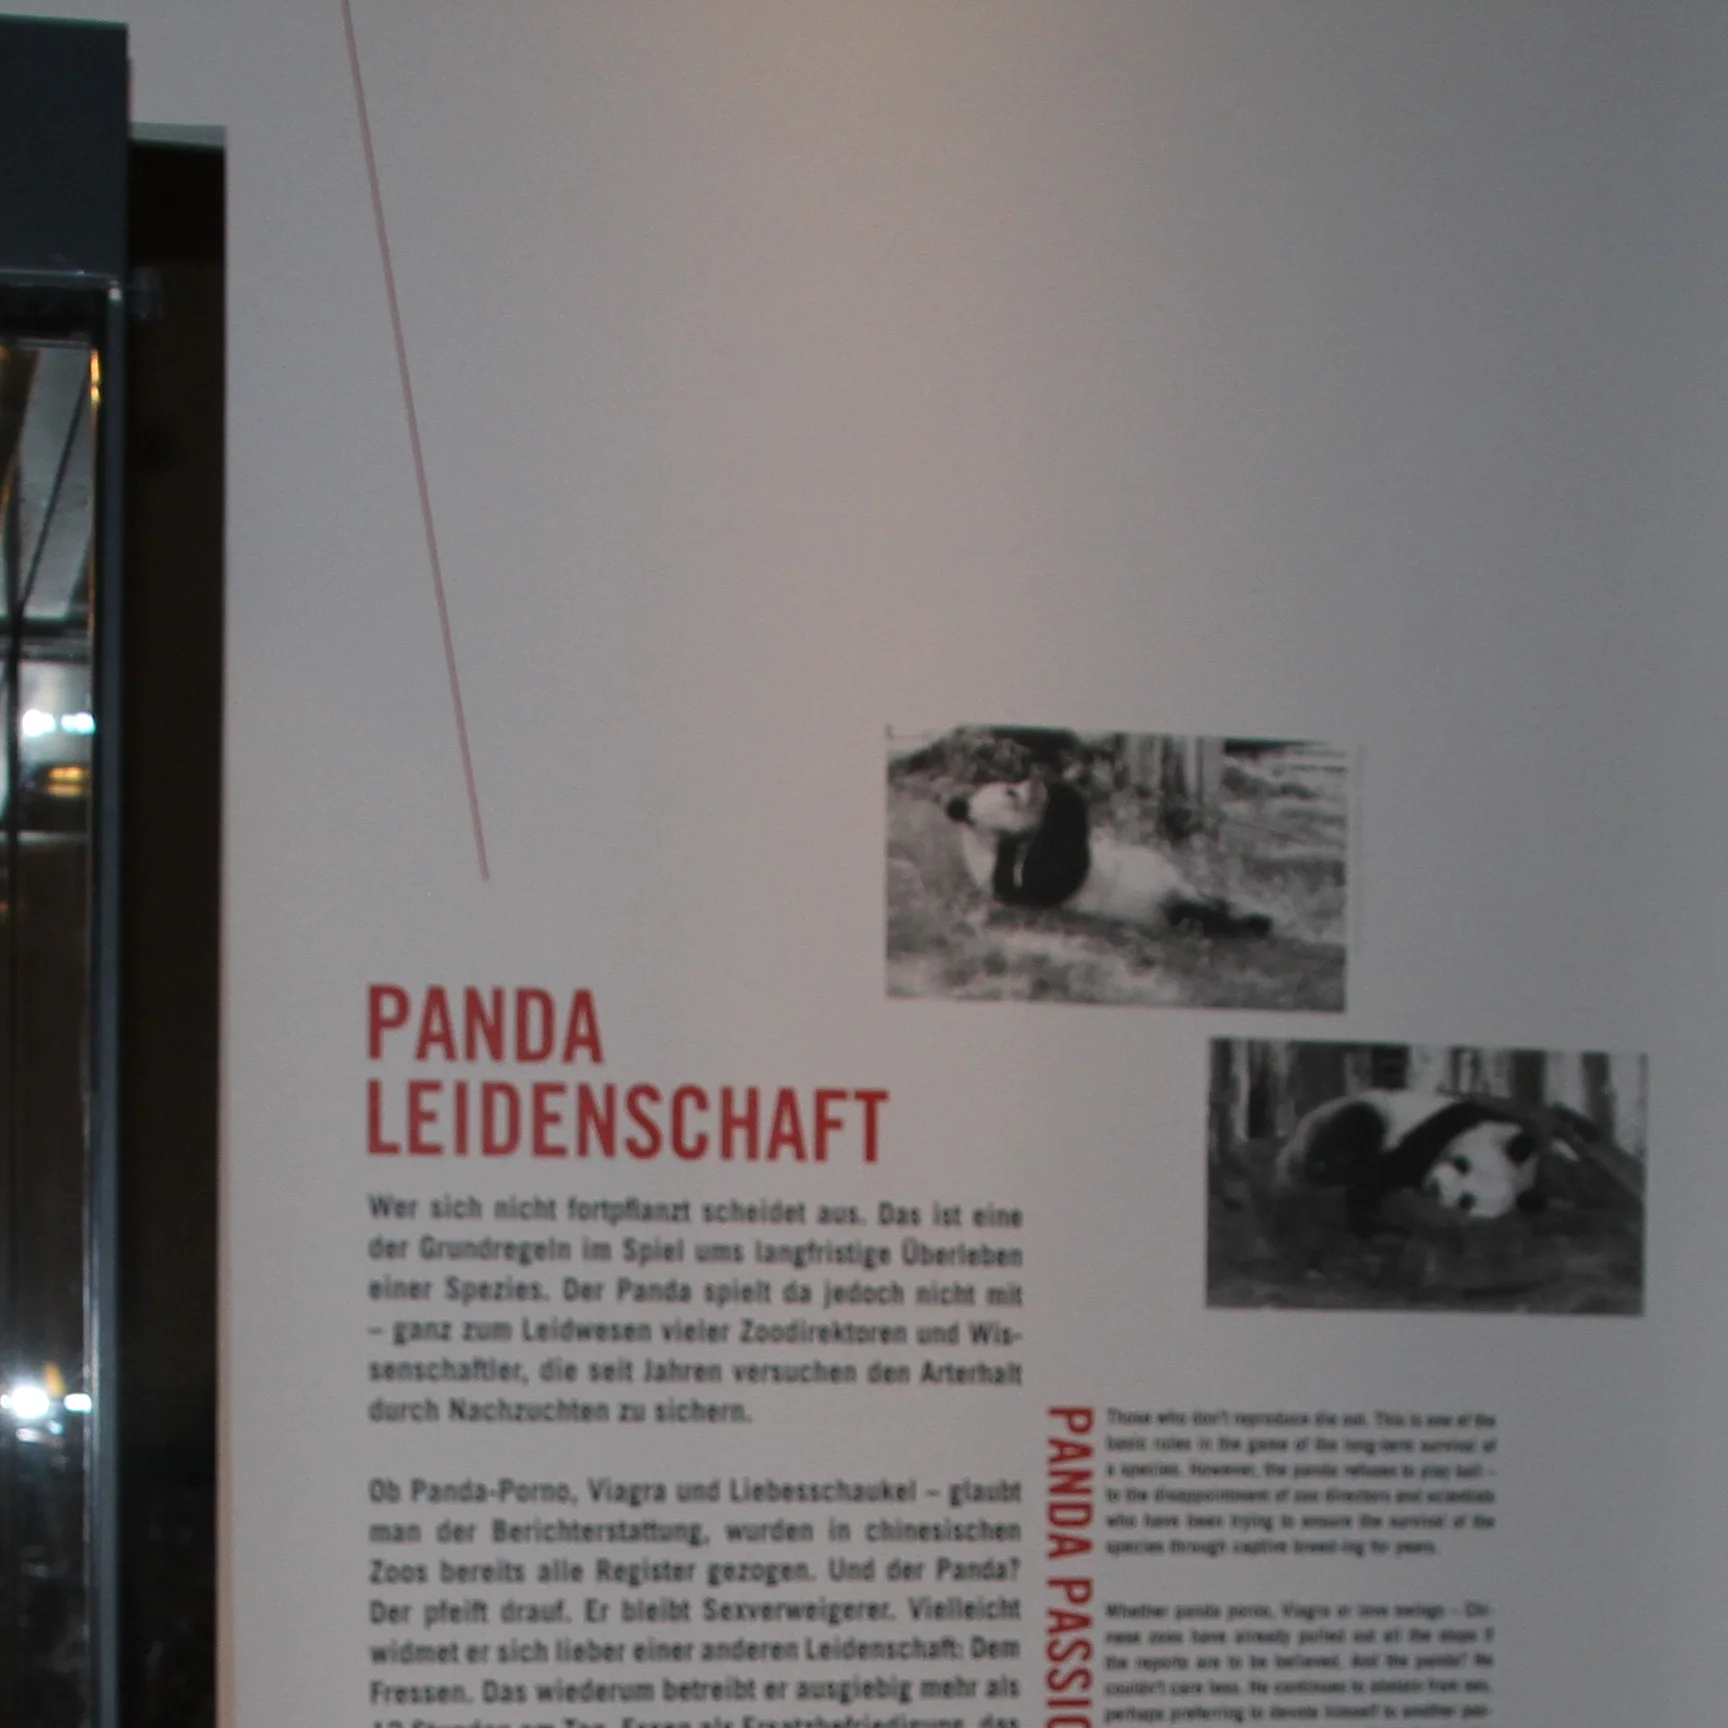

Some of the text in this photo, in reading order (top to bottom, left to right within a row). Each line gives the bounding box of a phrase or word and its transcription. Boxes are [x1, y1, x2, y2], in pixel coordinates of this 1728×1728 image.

[368, 984, 604, 1064] PANDA
[368, 1080, 889, 1162] LEIDENSCHAFT
[367, 1195, 1024, 1229] Wer sich nicht fortpflanzt scheidet aus. Das ist eine
[367, 1235, 1023, 1271] der Grundregeln im Spiel ums langfristige Überleben
[367, 1276, 1023, 1310] einer Spezies. Der Panda spielt da jedoch nicht mit
[392, 1318, 1022, 1347] ganz zum Leidwesen vieler Zoodirektoren und Wis-
[539, 1358, 578, 1383] die
[588, 1360, 634, 1383] seit
[643, 1359, 723, 1384] Jahren
[732, 1361, 857, 1384] versuchen
[866, 1362, 911, 1385] den
[919, 1361, 1023, 1386] Arterhalt
[367, 1398, 753, 1424] durch Nachzuchten zu sichern.
[368, 1477, 402, 1504] Ob
[587, 1479, 668, 1508] Viagra
[675, 1479, 721, 1503] und
[948, 1480, 1022, 1509] glaubt
[1046, 1406, 1094, 1560] PANDA
[368, 1523, 422, 1544] man
[435, 1519, 477, 1544] der
[724, 1520, 814, 1542] wurden
[828, 1518, 851, 1542] in
[368, 1558, 429, 1585] Zoos
[439, 1560, 526, 1584] bereits
[536, 1559, 584, 1583] alle
[595, 1558, 696, 1588] Register
[828, 1557, 876, 1583] Und
[885, 1559, 925, 1582] der
[369, 1599, 412, 1625] Der
[423, 1599, 489, 1628] pfeift
[584, 1598, 610, 1624] Er
[621, 1599, 691, 1623] bleibt
[907, 1597, 1021, 1620] Vielleicht
[369, 1641, 460, 1666] widmet
[464, 1644, 491, 1664] er
[496, 1639, 549, 1664] sich
[555, 1640, 626, 1663] lieber
[632, 1642, 695, 1662] einer
[700, 1639, 799, 1662] anderen
[970, 1635, 1021, 1660] Dem
[481, 1679, 528, 1704] Das
[534, 1679, 655, 1704] wiederum
[662, 1678, 757, 1702] betreibt
[762, 1681, 788, 1701] er
[795, 1677, 913, 1706] ausgiebig
[919, 1676, 978, 1700] mehr
[985, 1676, 1021, 1699] als
